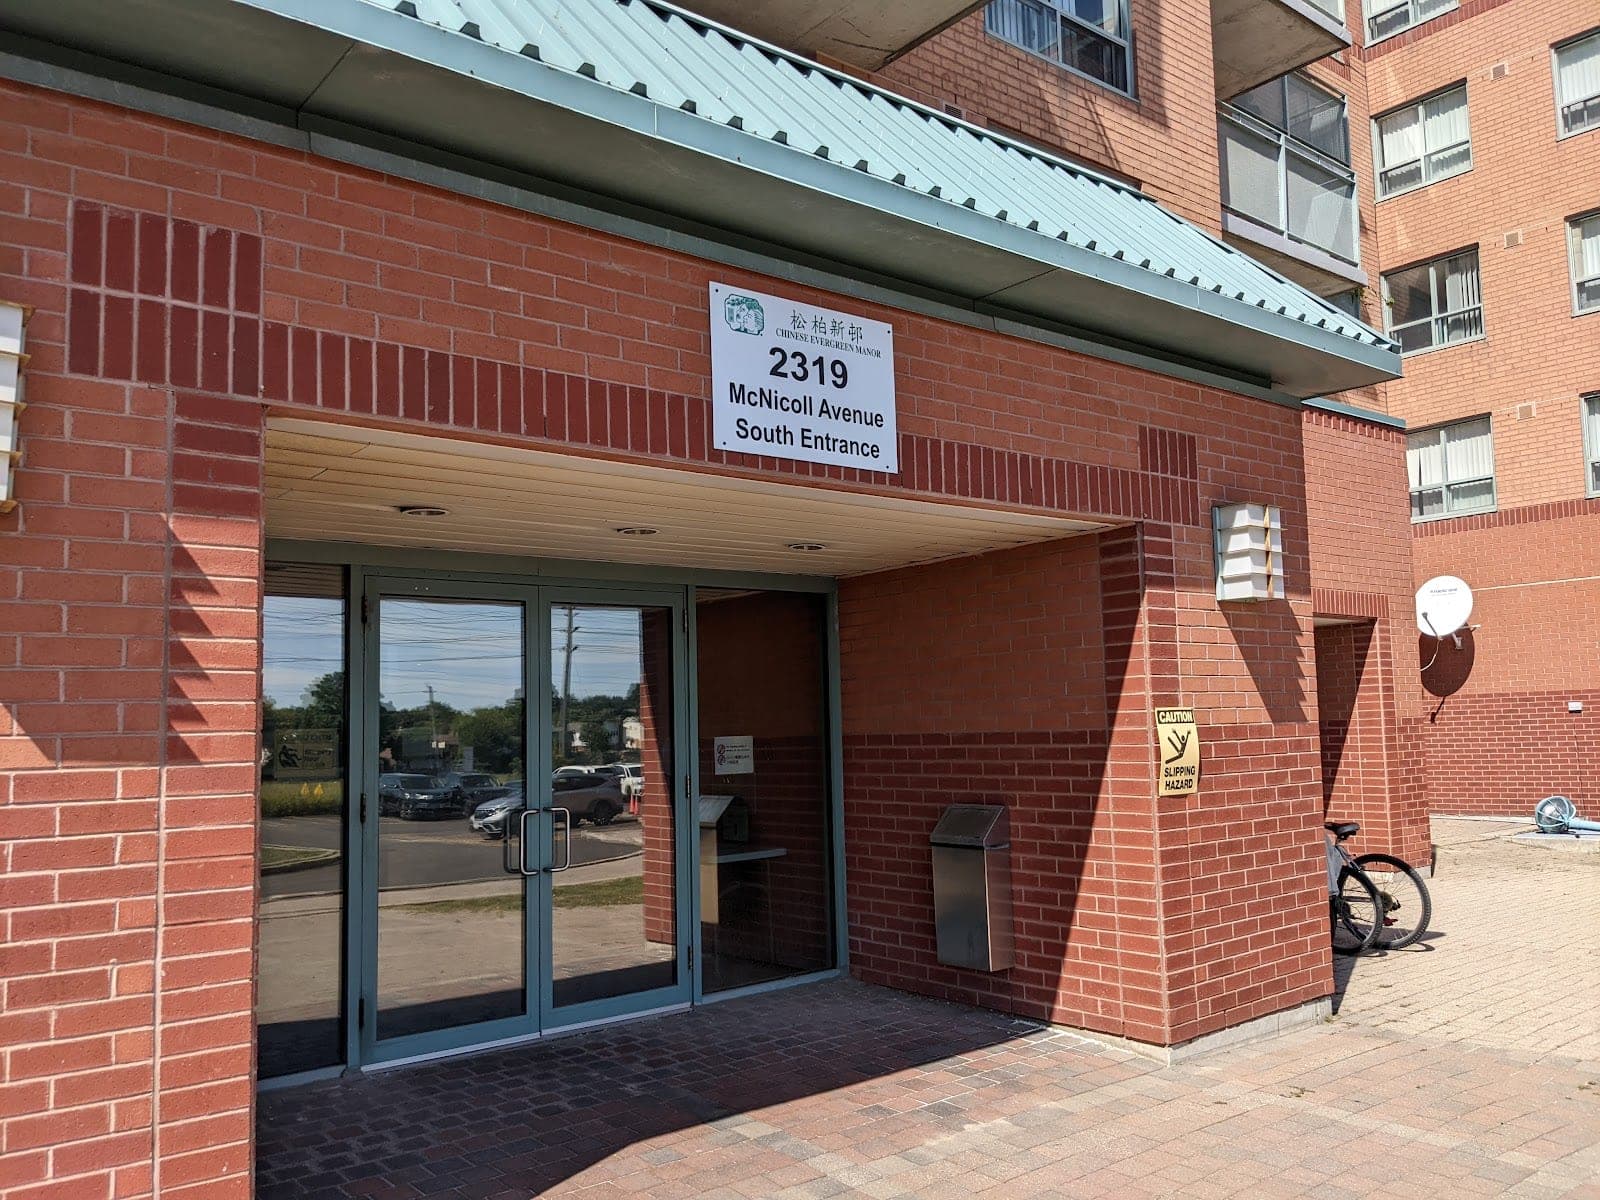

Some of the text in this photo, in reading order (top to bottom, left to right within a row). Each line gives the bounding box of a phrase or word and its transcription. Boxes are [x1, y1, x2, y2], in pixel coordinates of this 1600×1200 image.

[790, 309, 863, 344] 松柏新邨
[776, 328, 881, 358] CHINESE EVERGREEN MANOR
[769, 347, 848, 389] 2319
[729, 382, 884, 428] McNicoll Avenue
[736, 418, 880, 459] South Entrance
[1159, 710, 1194, 723] CAUTION
[1164, 766, 1196, 777] SLIPPING
[1165, 778, 1193, 790] HAZARD
